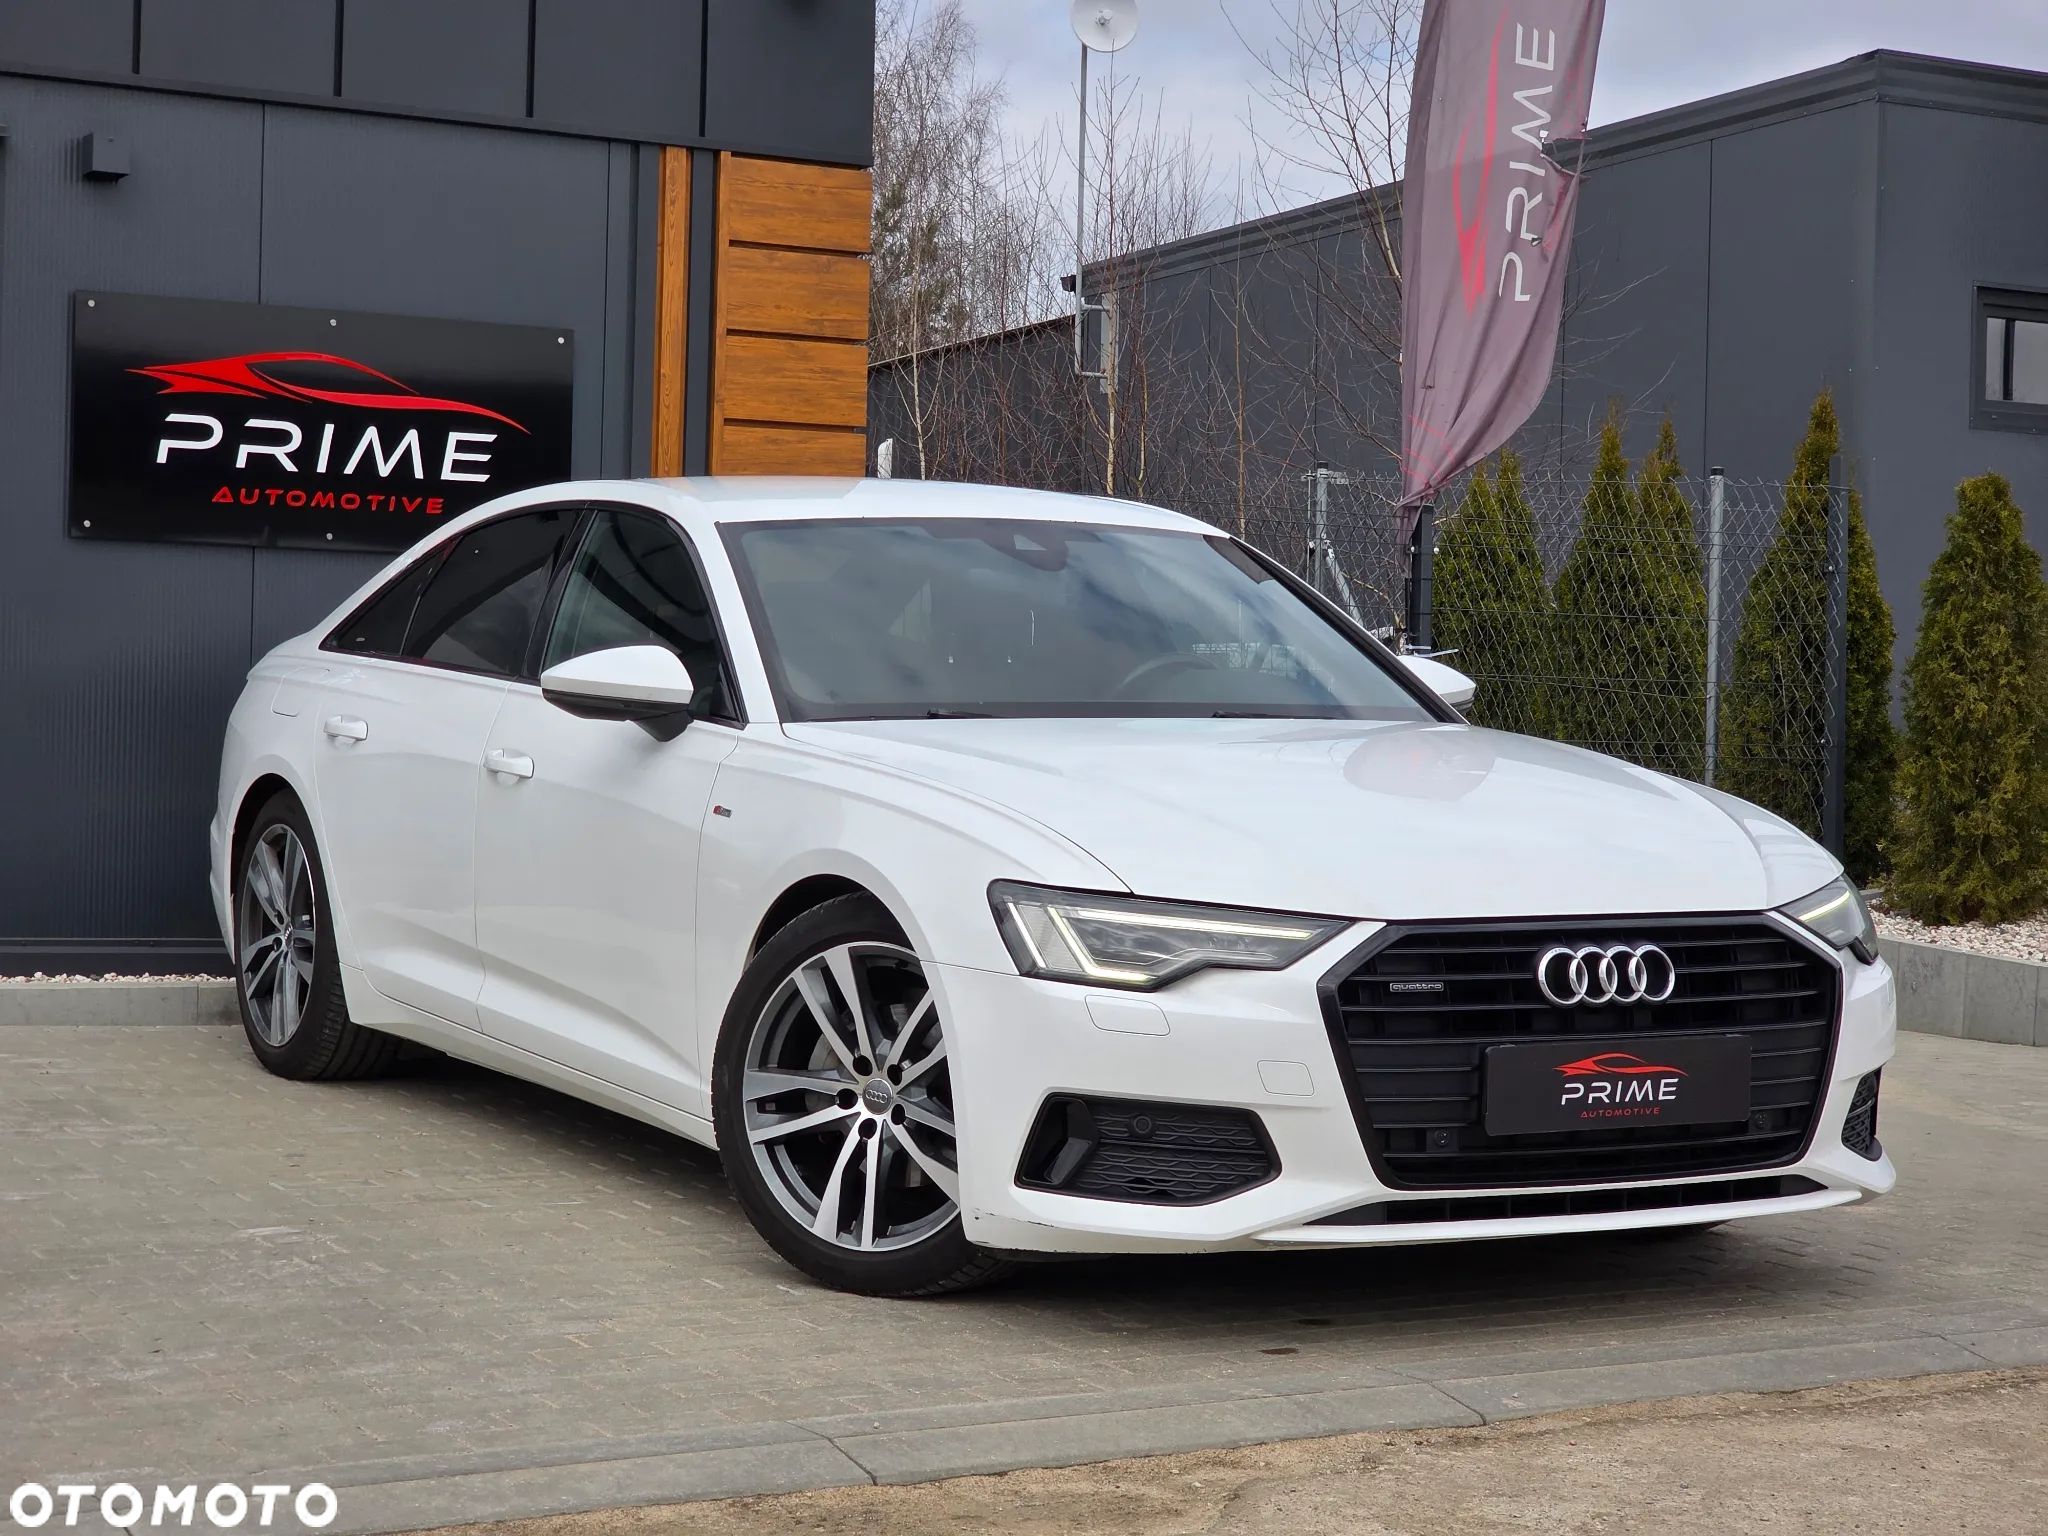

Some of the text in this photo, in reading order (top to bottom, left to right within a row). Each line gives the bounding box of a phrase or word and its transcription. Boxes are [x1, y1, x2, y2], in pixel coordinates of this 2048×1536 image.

[1498, 22, 1556, 302] PRIME
[156, 413, 498, 483] PRIME
[211, 486, 445, 515] AUTOMOTIVE
[1391, 982, 1443, 992] quattro
[1560, 1078, 1680, 1106] PRIME
[1580, 1107, 1661, 1118] AUTOMOTIVE
